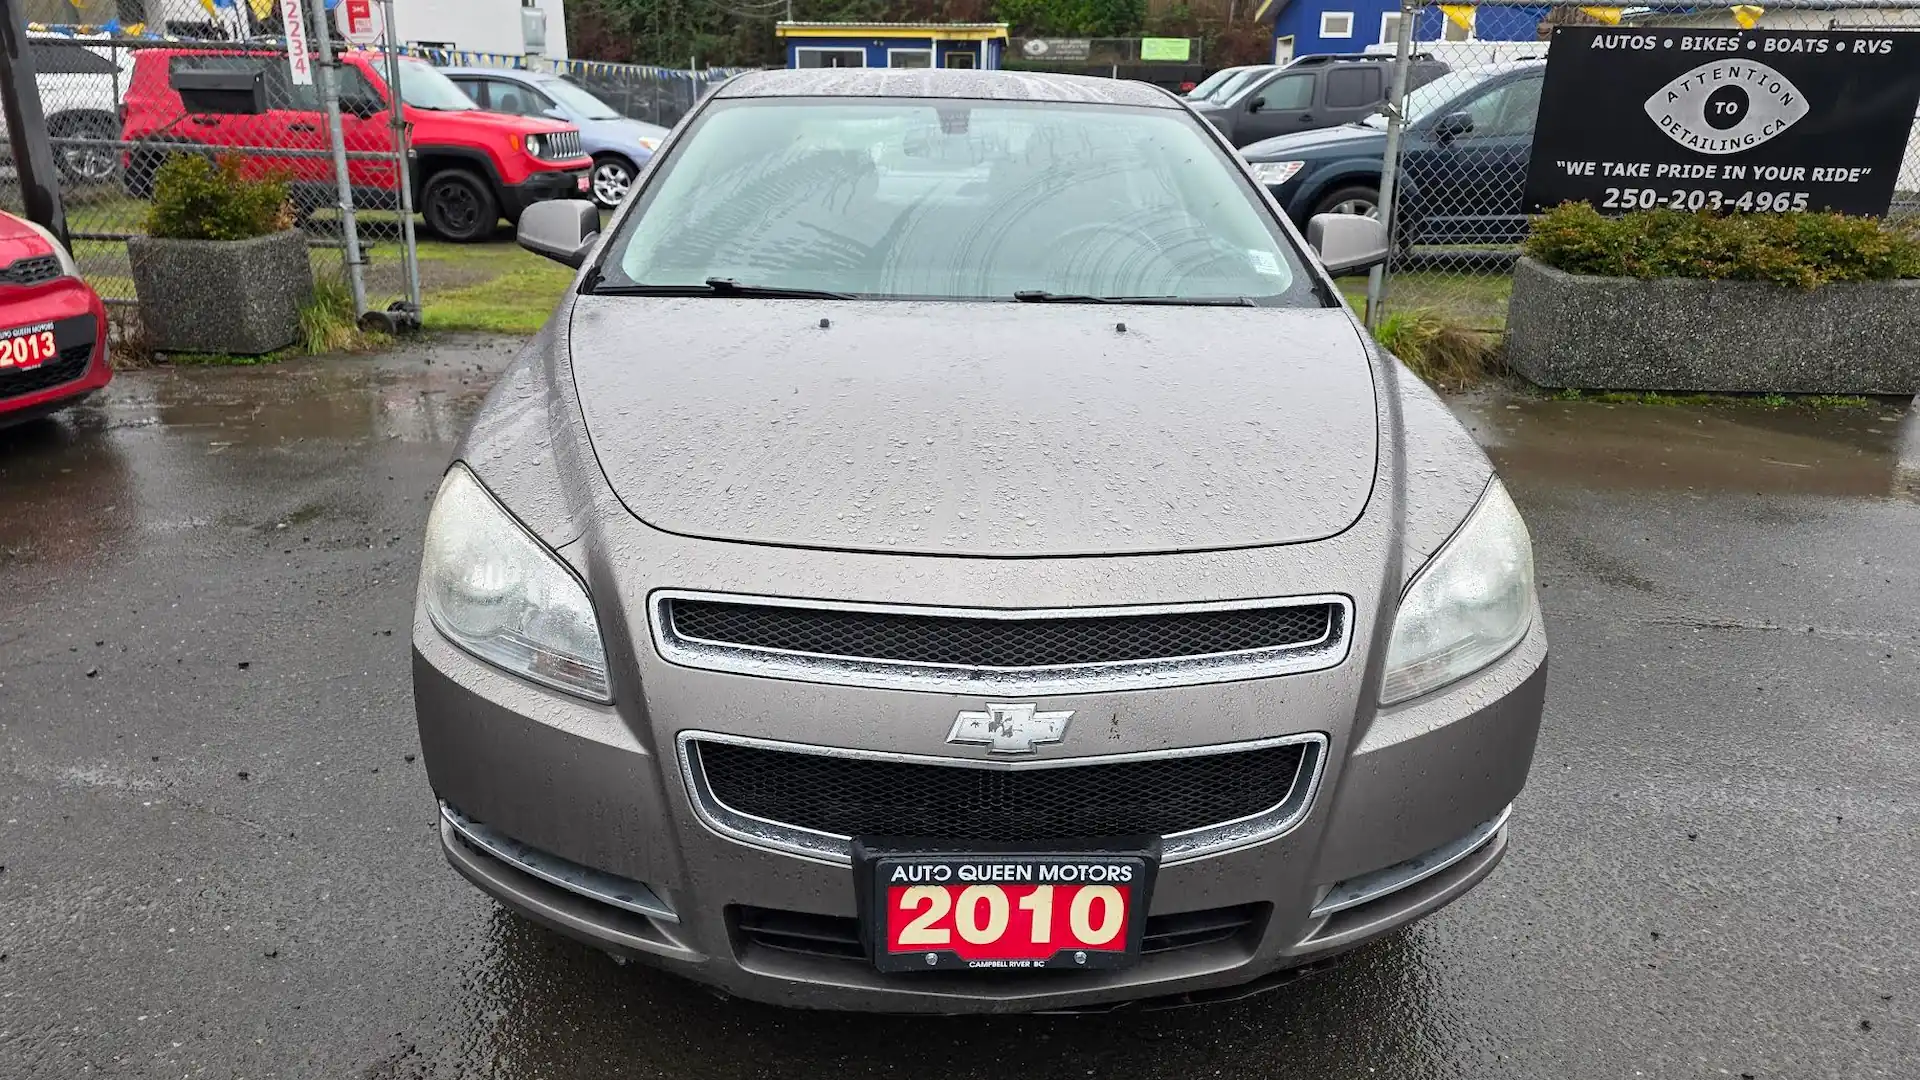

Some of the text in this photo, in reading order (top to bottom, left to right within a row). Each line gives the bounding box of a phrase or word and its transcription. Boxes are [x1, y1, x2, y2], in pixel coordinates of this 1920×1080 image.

[286, 1, 306, 75] 2234
[1591, 35, 1893, 55] AUTOS BIKES BOATS RVS
[1666, 65, 1793, 108] ATTENTION
[1714, 101, 1739, 115] TO
[1660, 114, 1787, 151] DETAILING.CA
[1602, 162, 1649, 178] TAKE
[1656, 163, 1718, 179] PRIDE
[1723, 165, 1746, 180] IN
[1753, 165, 1805, 181] YOUR
[1602, 187, 1810, 213] 250-203-4965
[0, 331, 56, 367] 2013
[890, 864, 1133, 882] AUTO QUEEN MOTORS
[897, 884, 1125, 945] 2010
[968, 960, 1045, 968] CAMPBELL RIVER BC
